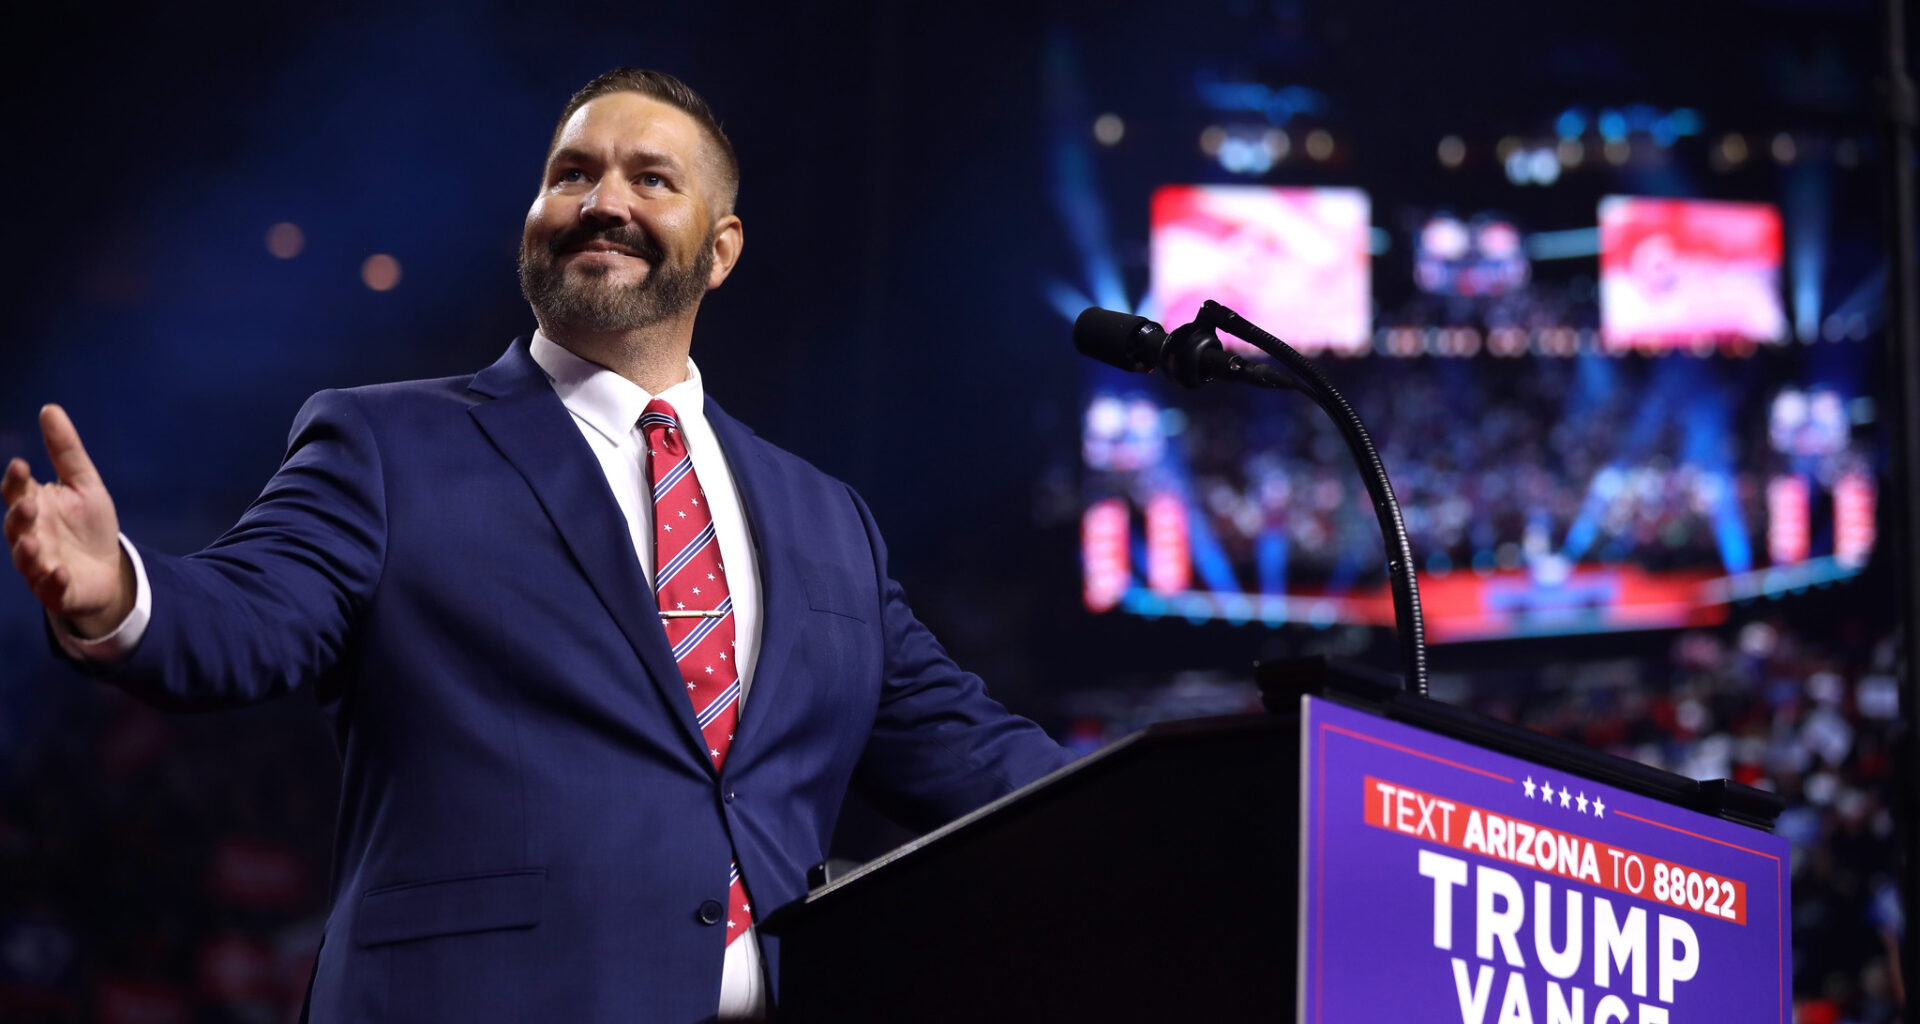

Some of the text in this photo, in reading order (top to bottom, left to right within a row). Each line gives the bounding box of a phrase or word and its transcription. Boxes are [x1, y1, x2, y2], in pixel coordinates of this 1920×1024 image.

[1376, 782, 1737, 920] TEXT ARIZONA TO 88022
[1418, 849, 1700, 1004] TRUMP
